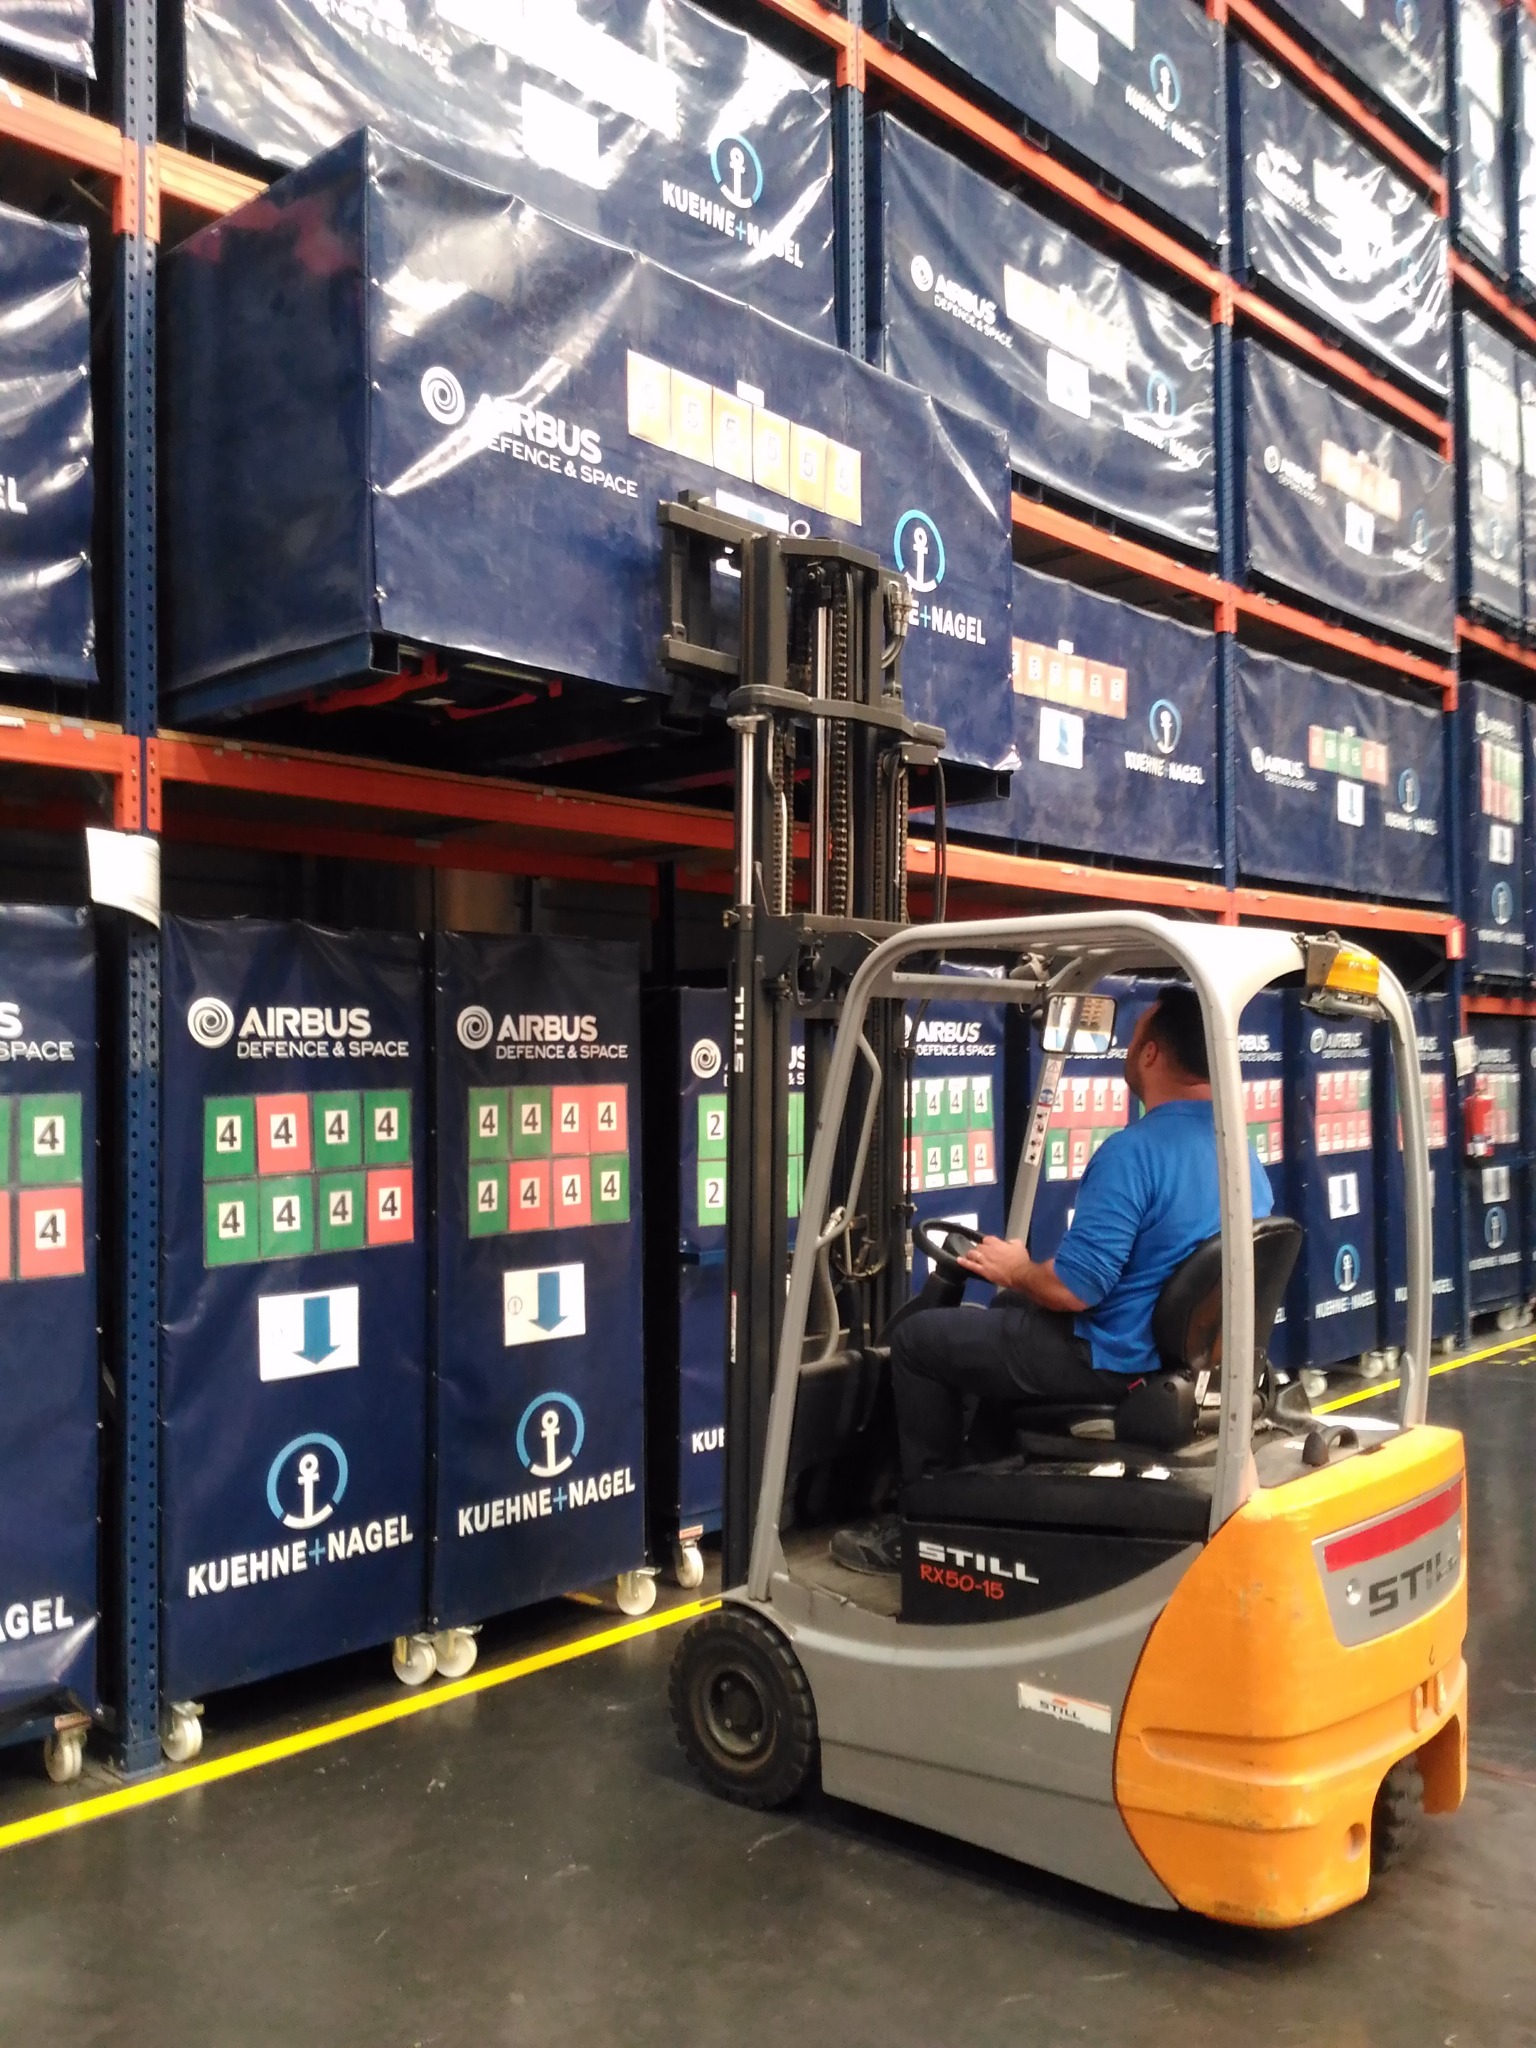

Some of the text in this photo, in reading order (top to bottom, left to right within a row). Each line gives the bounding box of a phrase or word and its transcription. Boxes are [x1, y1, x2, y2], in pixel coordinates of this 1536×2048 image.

[662, 180, 804, 269] KUEHNE+NAEL
[563, 460, 578, 479] &
[580, 464, 639, 498] SPACE
[802, 452, 815, 477] 5
[238, 1006, 372, 1039] AIRBUS
[496, 1014, 598, 1043] AIRBUS
[733, 986, 745, 1073] STILL
[915, 1021, 982, 1044] AIRBUS
[236, 1040, 410, 1060] DEFENCE & SPACE
[495, 1044, 628, 1060] DEFENCE & SPACE
[929, 1092, 985, 1112] 4 4 4
[37, 1118, 60, 1151] 4
[218, 1110, 395, 1149] 4 4 4 4
[481, 1104, 613, 1134] 4 4 4 4
[710, 1113, 721, 1137] 2
[929, 1150, 938, 1169] 4
[952, 1148, 960, 1165] 4
[480, 1174, 617, 1209] 4 4 4 4
[708, 1181, 720, 1204] 2
[38, 1212, 62, 1244] 4
[221, 1190, 398, 1234] 4 4 4 4
[457, 1466, 636, 1538] KUEHNE+NAGEL
[187, 1514, 414, 1599] KUEHNE+NAGEL
[918, 1540, 1040, 1585] STILL
[919, 1563, 1005, 1600] RX50-15
[1038, 1699, 1081, 1721] STILL
